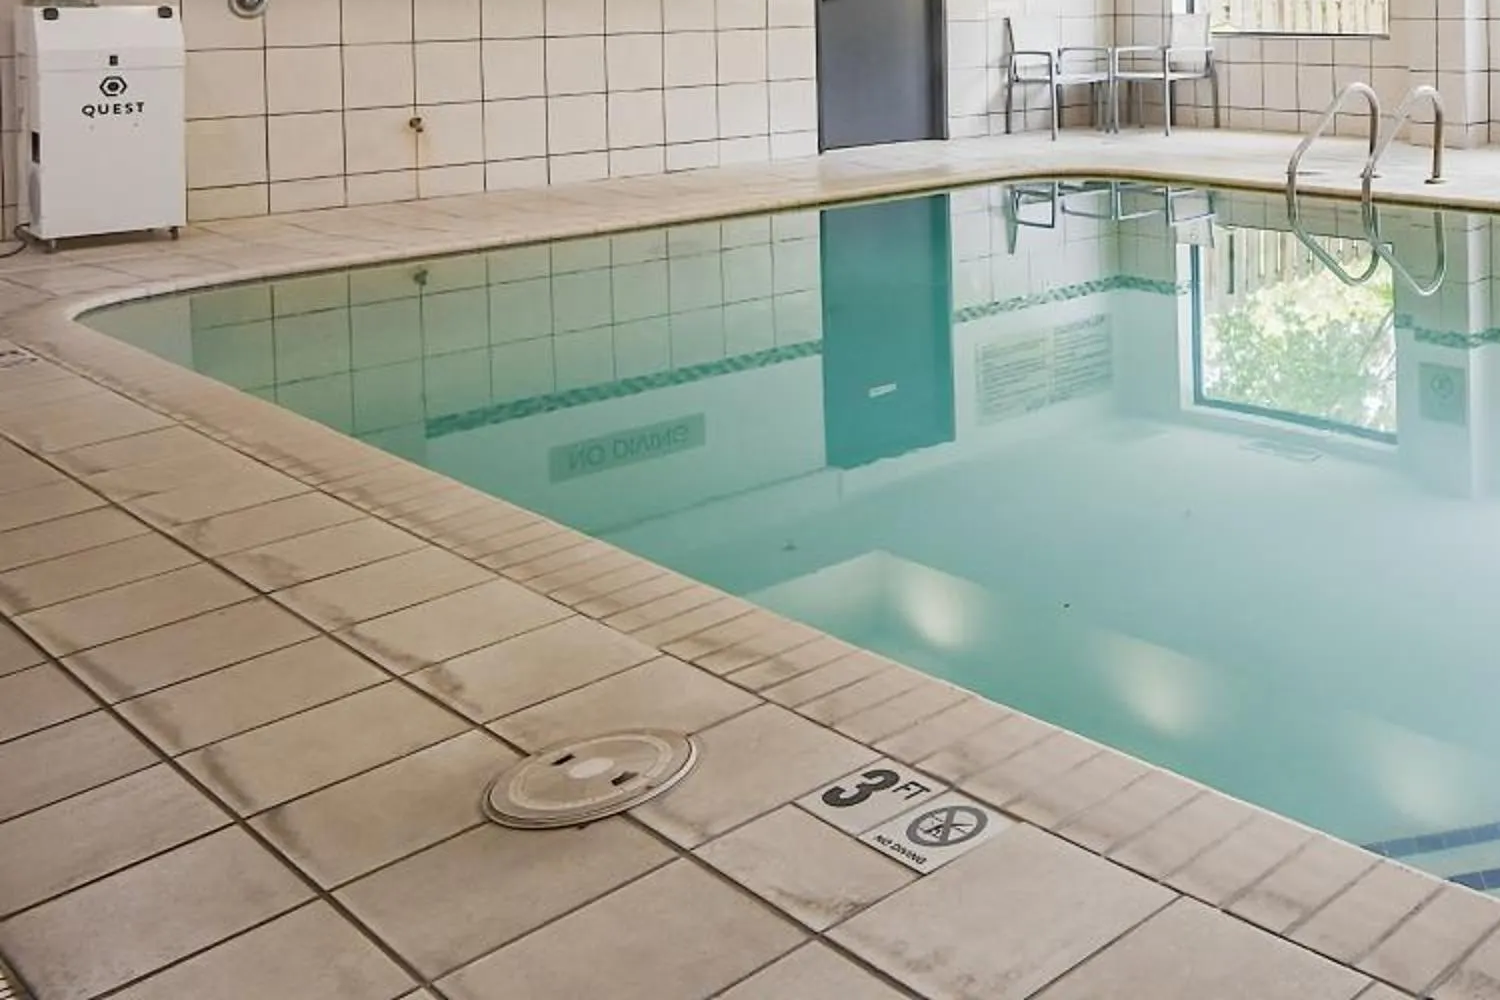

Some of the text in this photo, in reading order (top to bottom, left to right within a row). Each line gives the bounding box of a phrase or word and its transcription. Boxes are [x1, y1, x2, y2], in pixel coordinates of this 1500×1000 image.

[81, 101, 145, 119] QUEST
[821, 768, 931, 808] 3 FT
[873, 833, 928, 866] NO DIVING
